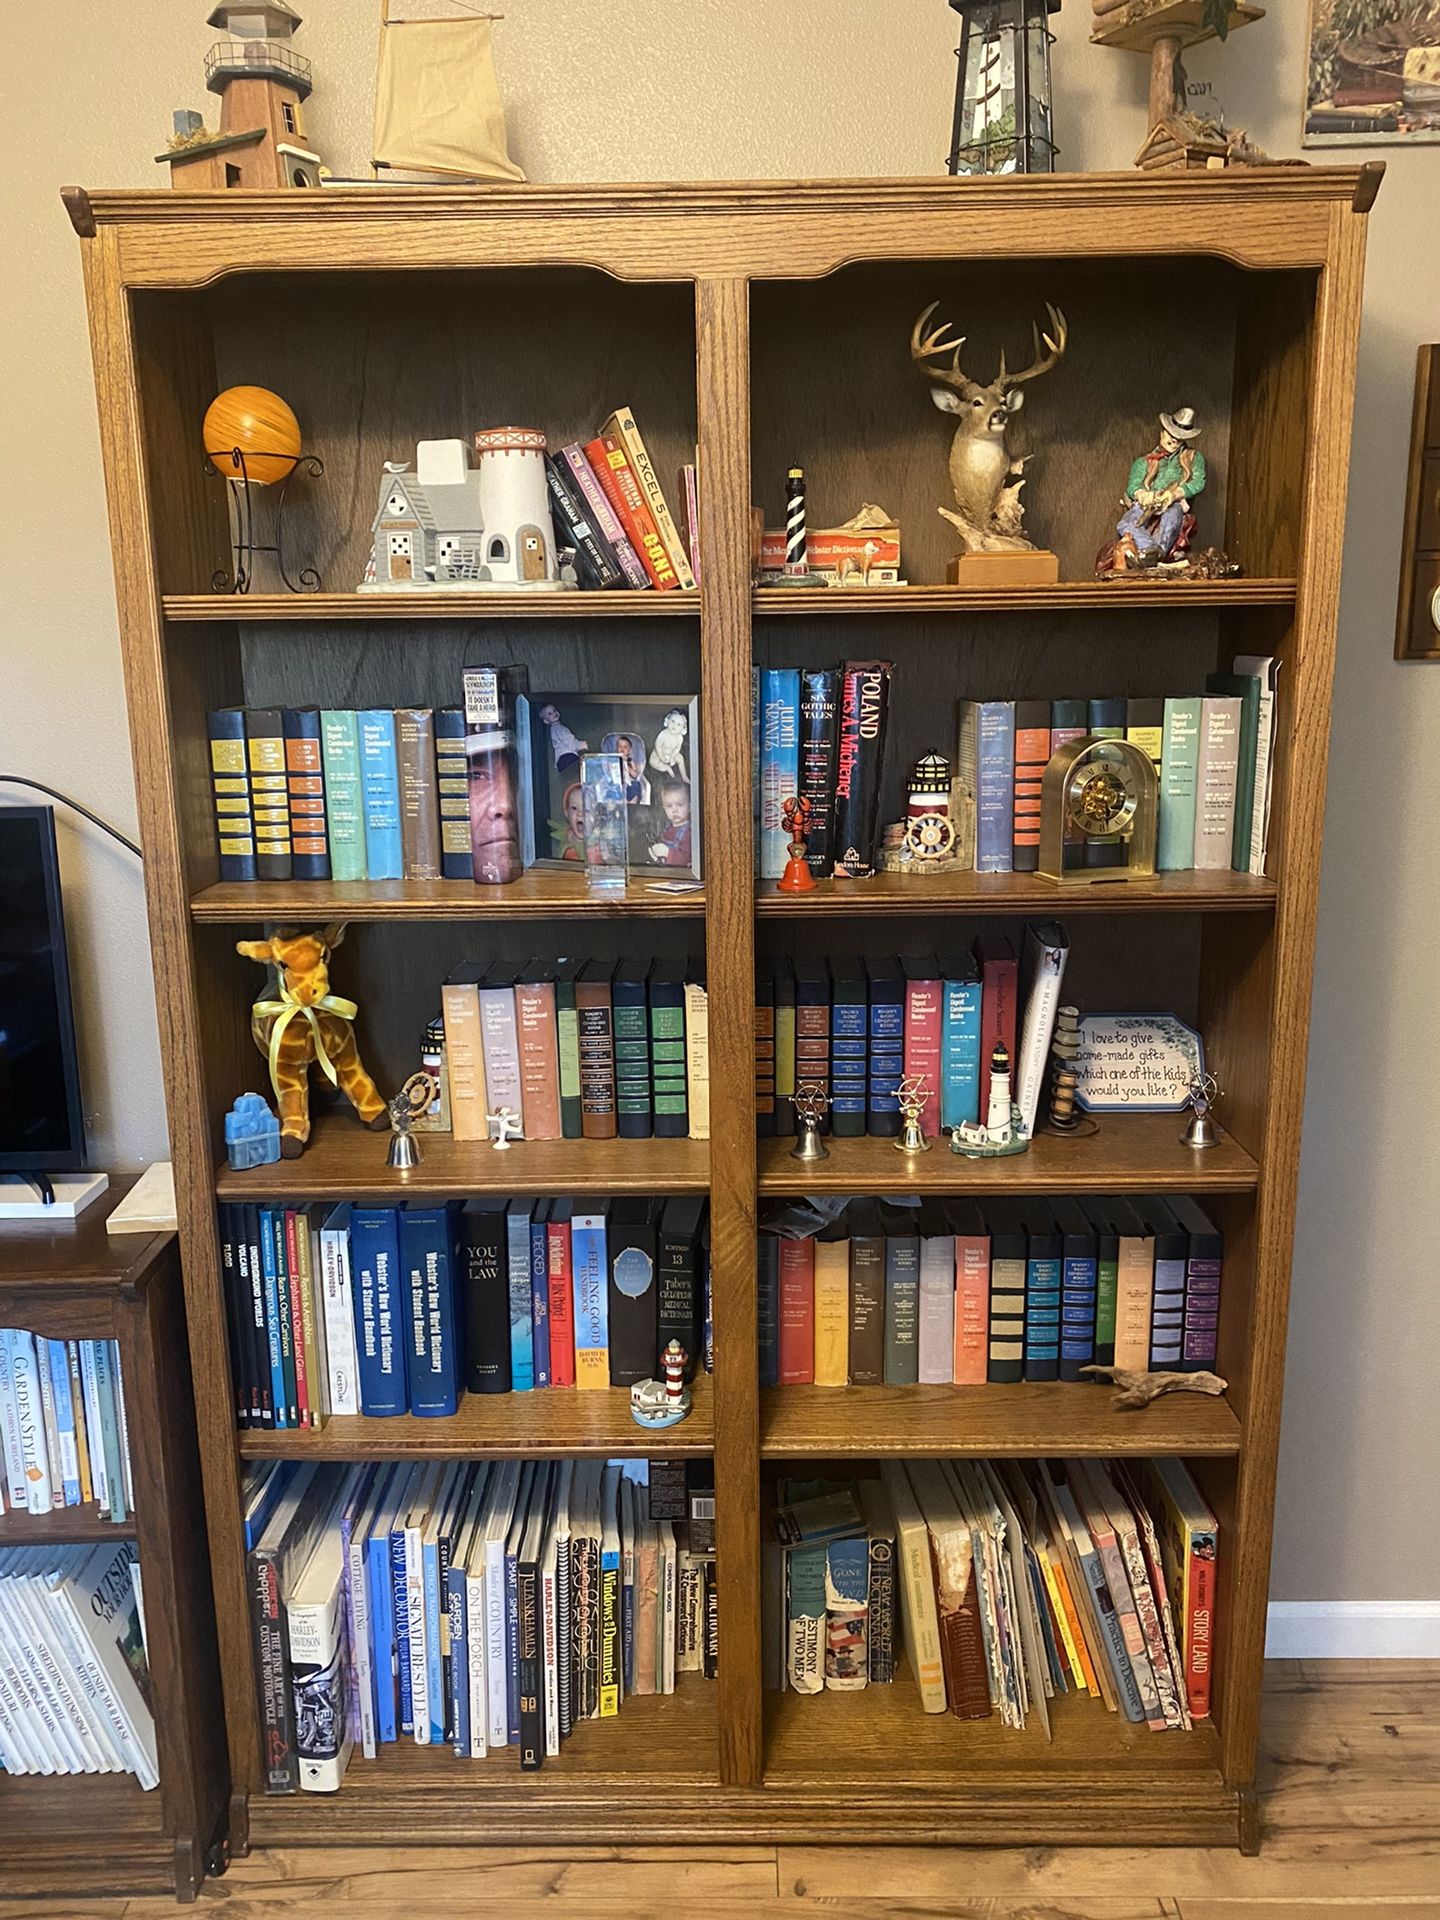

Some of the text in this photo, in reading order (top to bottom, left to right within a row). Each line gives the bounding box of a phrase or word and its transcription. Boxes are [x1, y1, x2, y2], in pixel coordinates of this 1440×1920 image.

[636, 452, 666, 514] EXCEL 5
[643, 532, 674, 584] GONE
[801, 703, 837, 711] GOTHIC
[804, 711, 833, 720] TALES
[810, 695, 827, 703] SIX
[858, 672, 883, 740] POLAND
[835, 735, 859, 799] Michener
[1091, 1030, 1114, 1044] love
[1115, 1031, 1128, 1044] to
[1131, 1032, 1154, 1048] give
[1139, 1048, 1166, 1065] gifts
[1086, 1083, 1119, 1097] would
[1121, 1086, 1147, 1101] you
[1109, 1070, 1128, 1080] one
[1131, 1066, 1144, 1080] of
[1143, 1066, 1162, 1080] the
[224, 1244, 233, 1268] FLOOD
[238, 1244, 249, 1278] VOLCANO
[467, 1246, 499, 1258] YOU
[469, 1267, 499, 1280] LAW
[470, 1258, 498, 1266] and the
[532, 1235, 544, 1276] DECKED
[672, 1254, 684, 1265] 13
[249, 1245, 264, 1328] UNDERGROUND WORLDS
[290, 1275, 301, 1310] Elephants
[580, 1265, 591, 1314] HANDBOOK
[589, 1250, 602, 1345] FEELING GOOD
[664, 1299, 691, 1310] MEDICAL
[280, 1302, 289, 1322] Other
[293, 1317, 302, 1341] Other
[361, 1270, 377, 1357] with Student Handbook
[376, 1252, 393, 1375] Webster's New World Dictionary
[411, 1270, 427, 1357] with Student Handbook
[426, 1252, 443, 1374] Webster's New World Dictionary
[269, 1315, 280, 1369] Sea Creatures
[295, 1340, 304, 1361] Land
[579, 1351, 599, 1359] DAVID
[39, 1364, 52, 1411] COUNTRY
[296, 1360, 306, 1382] Giants
[12, 1356, 38, 1470] GARDEN STYLE
[392, 1537, 406, 1565] NEW
[441, 1544, 449, 1582] COUNTRY
[507, 1561, 518, 1589] SMART
[833, 1566, 861, 1579] GONE
[352, 1554, 366, 1630] COTTAGE LIVING
[393, 1568, 409, 1640] DECORATOR
[453, 1592, 463, 1640] GARDEN
[508, 1597, 519, 1625] SIMPLE
[519, 1570, 537, 1660] TUTANKHAMUN
[677, 1568, 689, 1656] A-Z Crossword Dictionary
[687, 1568, 699, 1652] The New Comprehensive
[871, 1575, 882, 1650] DICTIONARY
[881, 1575, 893, 1652] NEW WORLD
[469, 1585, 483, 1678] ON THE PORCH
[490, 1599, 503, 1660] COUNTRY
[545, 1577, 555, 1667] HARLEY-DAVIDSON
[602, 1571, 618, 1686] Windows Dummies
[625, 1629, 633, 1643] AID
[708, 1593, 718, 1657] DICTIONARY
[794, 1627, 806, 1656] TWO
[1191, 1609, 1210, 1674] STORY LAND
[36, 1642, 66, 1690] STRETCHING
[74, 1664, 98, 1699] KITCHEN
[259, 1624, 277, 1726] CUSTOM MOTORCYCLE
[271, 1630, 284, 1695] THE FINE ART
[400, 1661, 410, 1694] BARNARD
[1107, 1611, 1140, 1708] Practice to Deceive
[5, 1666, 33, 1710] BEDROOMS
[18, 1668, 58, 1734] FLOORS STAIRS
[86, 1661, 130, 1741] OUTSIDE YOUR HOUSE
